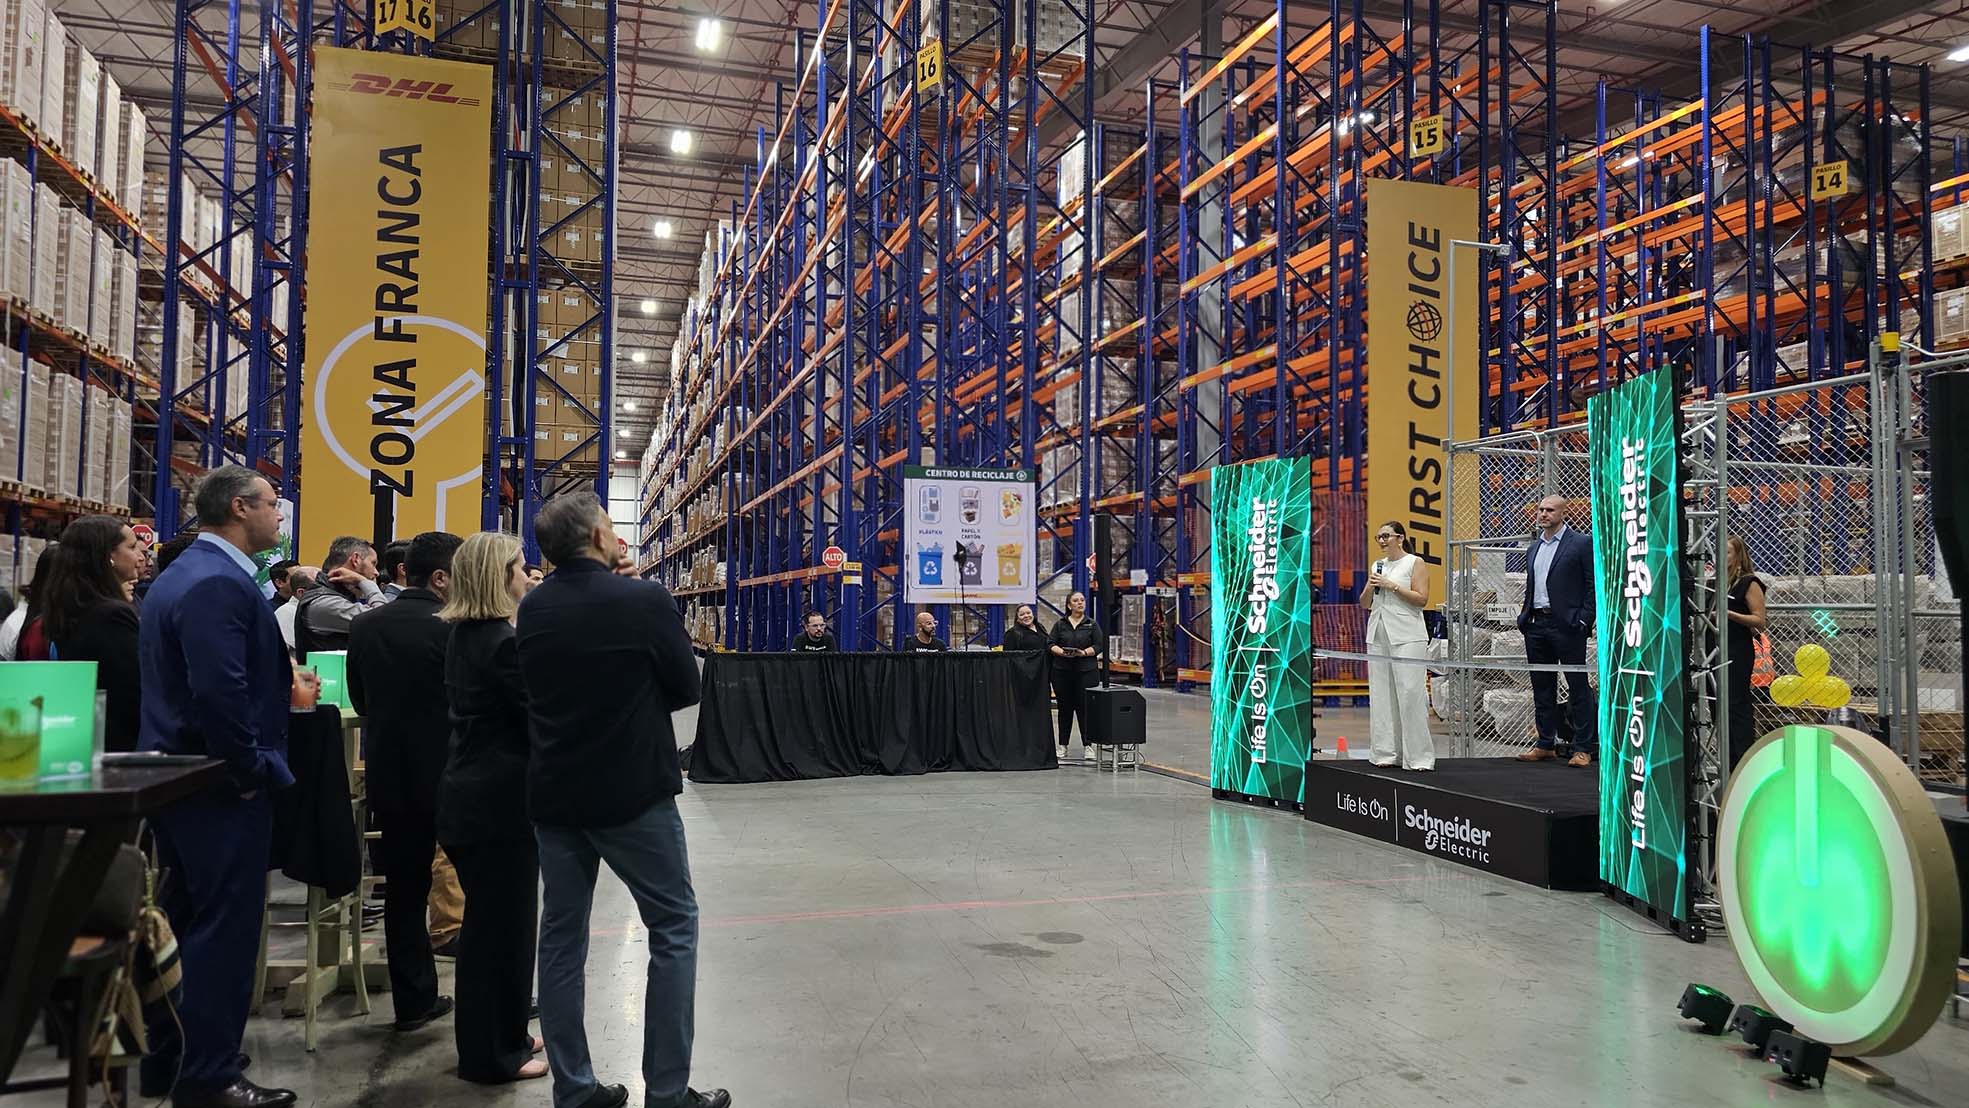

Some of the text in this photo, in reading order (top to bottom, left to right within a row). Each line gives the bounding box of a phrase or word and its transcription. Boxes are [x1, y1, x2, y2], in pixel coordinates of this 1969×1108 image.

[379, 0, 397, 24] 17
[406, 0, 431, 29] 16
[920, 56, 936, 83] 16
[350, 73, 460, 103] DHL
[1415, 119, 1438, 129] PASILLO
[1415, 128, 1438, 149] 15
[1816, 164, 1842, 174] PASILLO
[1816, 172, 1842, 192] 14
[370, 144, 422, 497] ZONA FRANCA
[925, 469, 1015, 480] CENTRO DE RECICLAJE
[1408, 421, 1442, 566] FIRST
[1635, 437, 1649, 555] Electric
[1266, 499, 1278, 575] Electric
[1621, 437, 1642, 648] Schneider
[825, 553, 842, 561] ALTO
[1248, 496, 1267, 634] Schneider
[1250, 664, 1266, 764] Life Is On
[1629, 696, 1646, 850] Life Is On
[1337, 791, 1389, 821] Life Is On
[1405, 804, 1492, 847] Schneider
[1440, 836, 1490, 864] Electric
